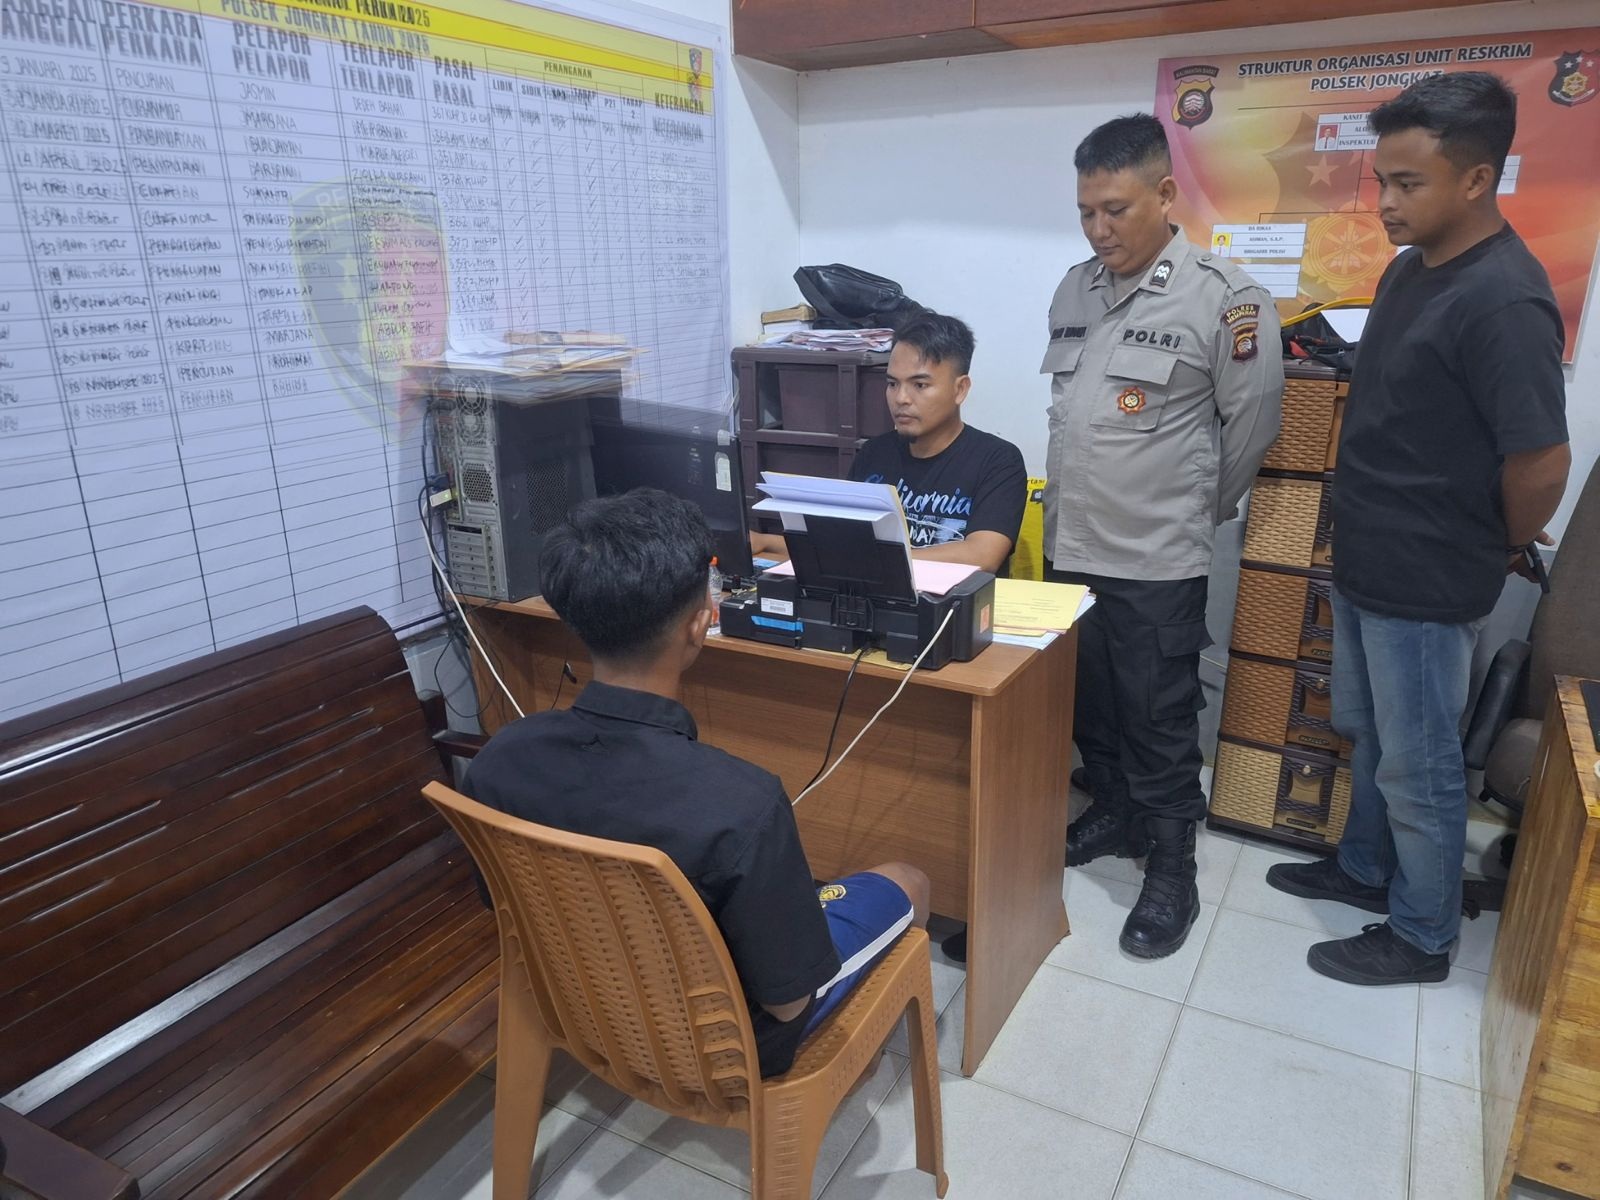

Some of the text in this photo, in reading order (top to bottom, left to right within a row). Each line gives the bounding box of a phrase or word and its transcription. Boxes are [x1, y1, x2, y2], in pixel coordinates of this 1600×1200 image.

[101, 0, 202, 40] PERKARA
[232, 21, 312, 56] PELAPOR
[232, 46, 312, 83] PELAPOR
[341, 40, 415, 72] TERLAPOR
[434, 55, 476, 82] PASAL
[1238, 43, 1532, 76] STRUKTUR ORGANISASI UNIT RESKRIM
[340, 63, 415, 99] TERLAPOR
[492, 79, 513, 92] LIDIK
[521, 84, 541, 97] SIDIK
[1311, 70, 1443, 91] POLSEK JONGKA
[654, 92, 704, 115] KETERANGAN
[1122, 328, 1181, 349] POLRI
